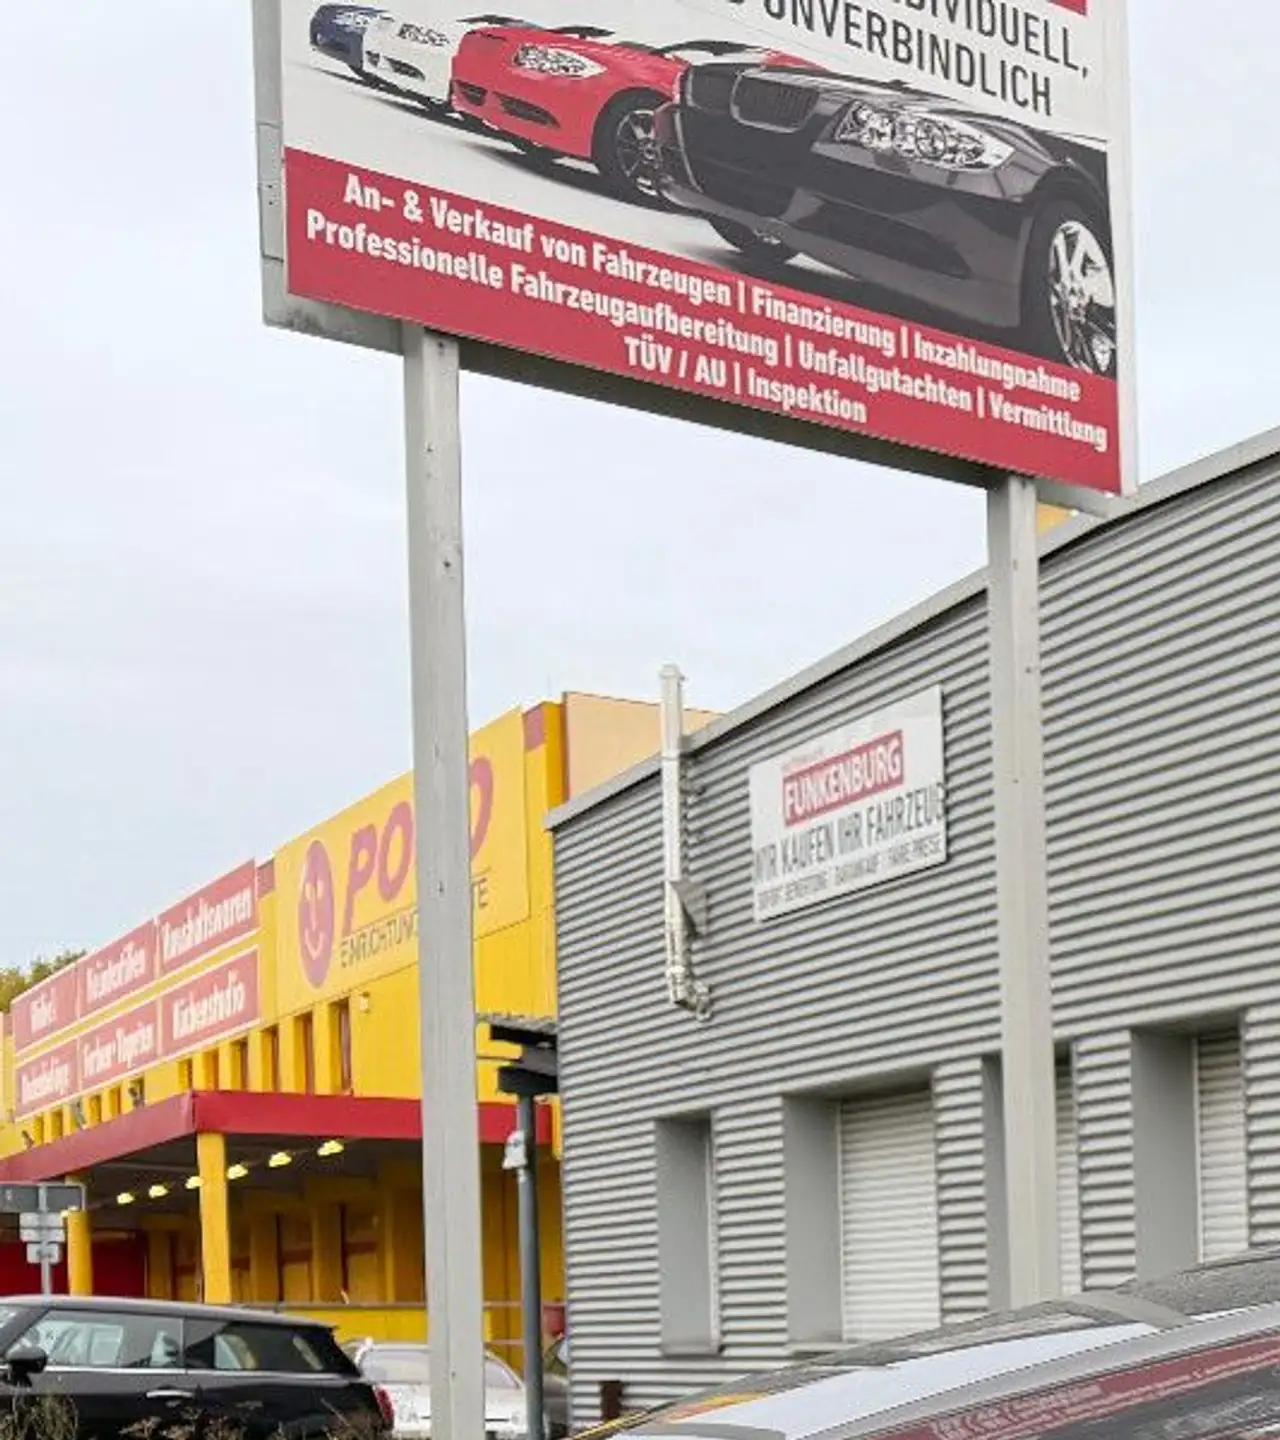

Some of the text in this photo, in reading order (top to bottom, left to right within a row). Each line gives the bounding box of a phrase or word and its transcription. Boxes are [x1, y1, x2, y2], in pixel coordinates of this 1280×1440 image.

[307, 208, 503, 290] Professionelle
[511, 263, 779, 367] Fahrzeugaufbereitung
[799, 340, 973, 412] Unfallgutachten
[989, 391, 1108, 452] Vermittlung
[343, 173, 396, 212] An-
[402, 190, 424, 223] &
[430, 196, 534, 253] Verkauf
[540, 234, 586, 269] von
[593, 242, 732, 306] Fahrzeugen
[751, 286, 896, 356] Finanzierung
[914, 333, 1082, 402] Inzahlungnahme
[624, 334, 673, 375] TÜV
[678, 350, 688, 379] /
[694, 355, 727, 388] AU
[748, 367, 867, 424] Inspektion
[785, 738, 902, 821] FUNKENBURG
[781, 820, 834, 877] KAUFEN
